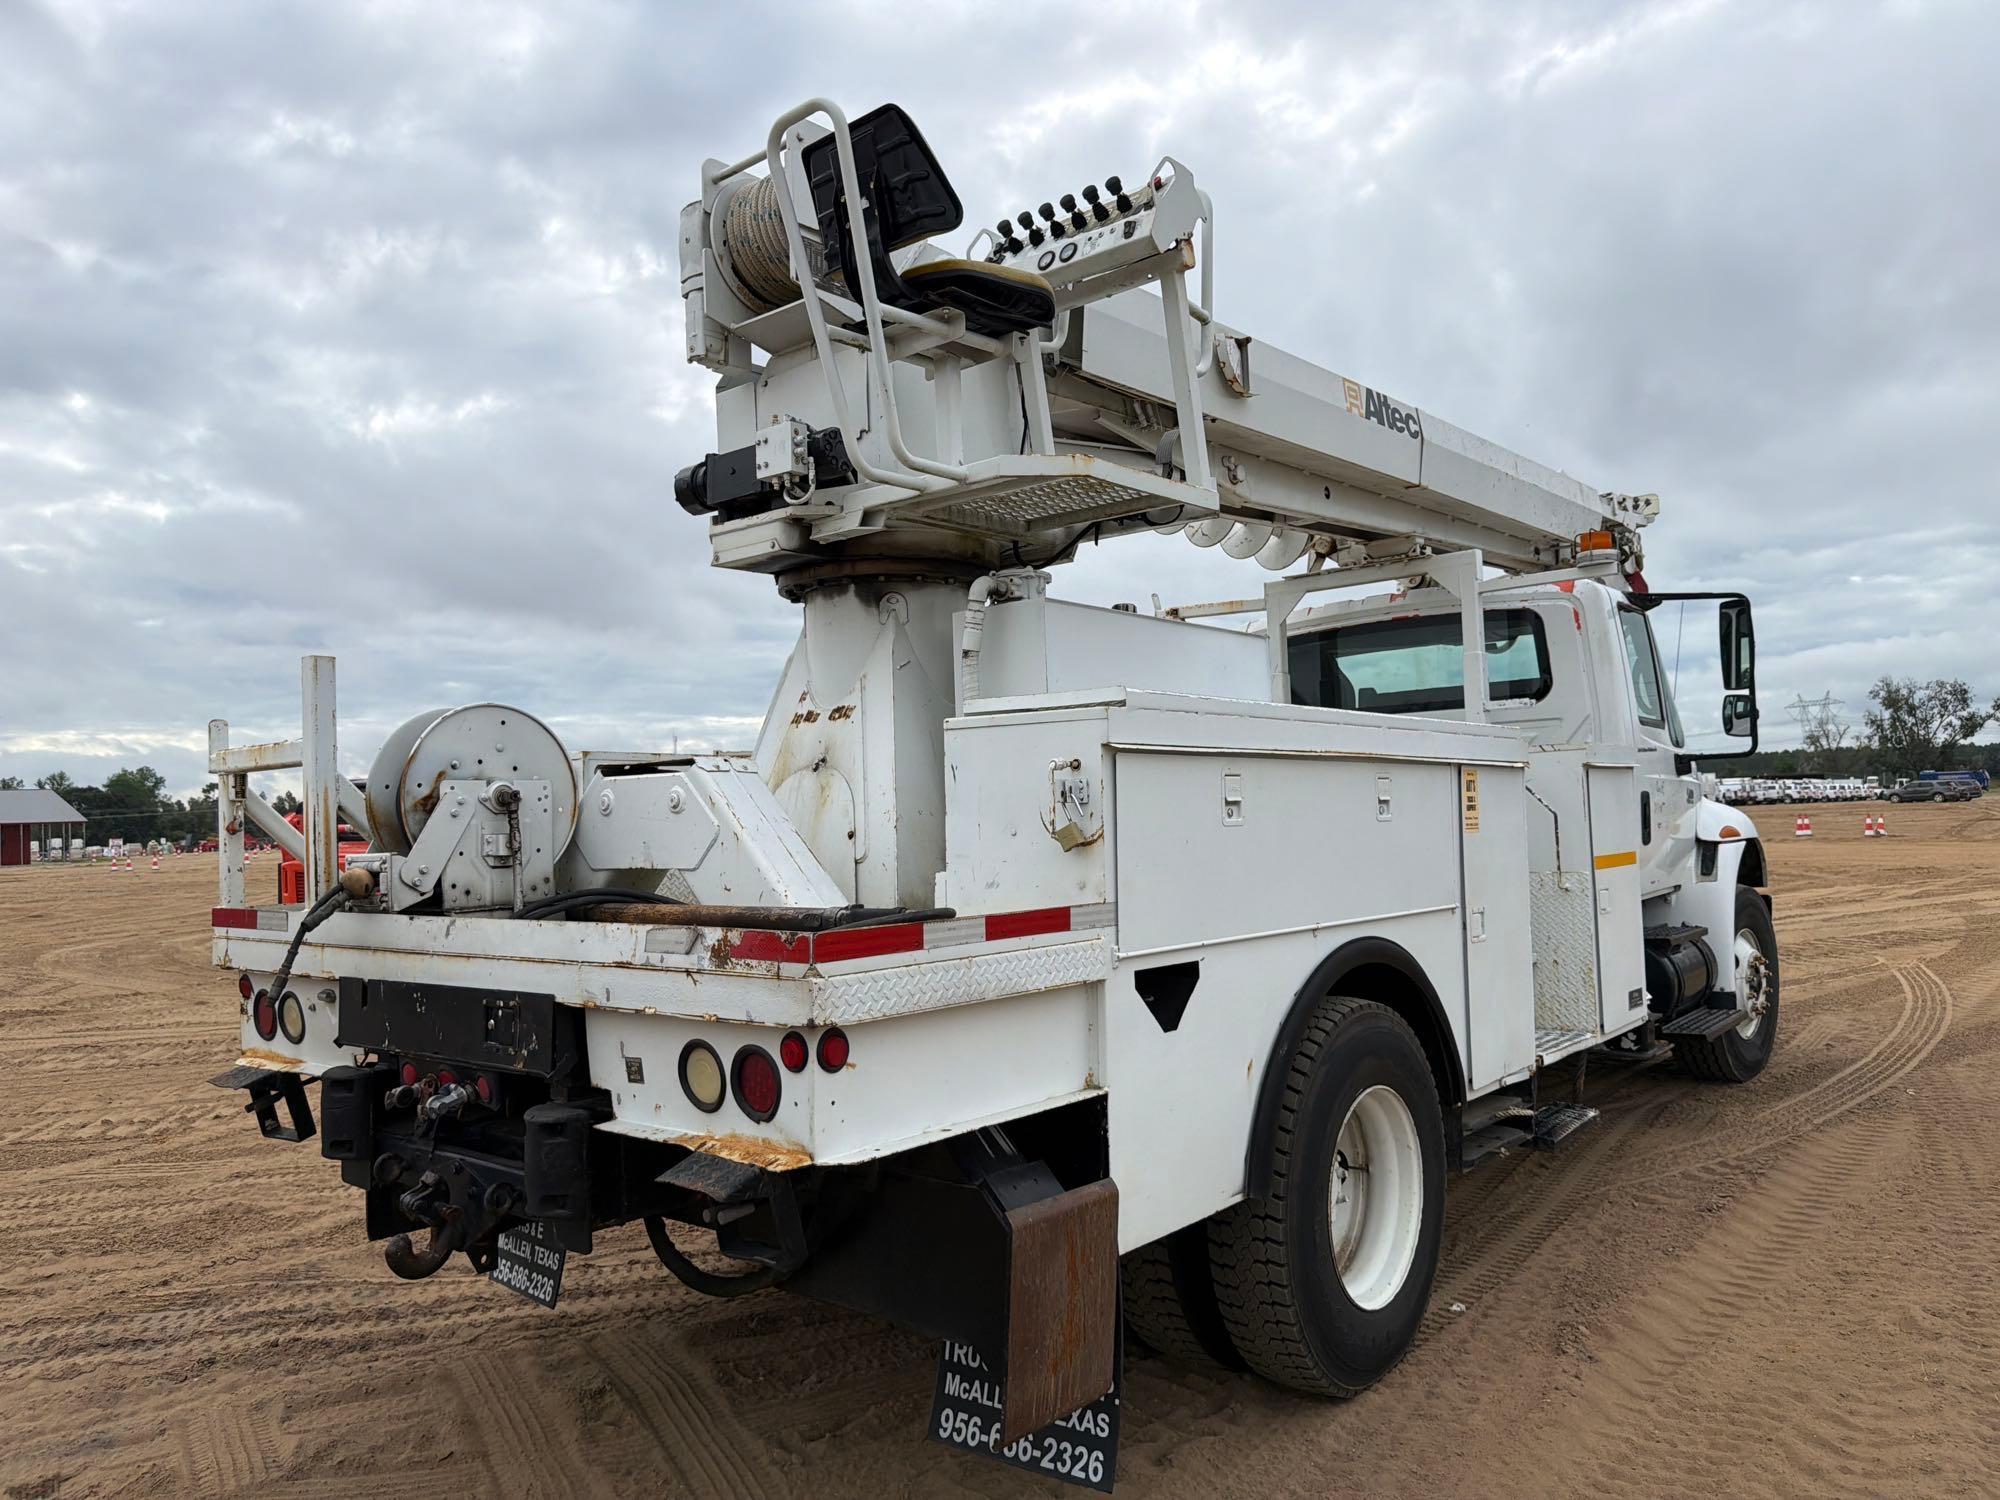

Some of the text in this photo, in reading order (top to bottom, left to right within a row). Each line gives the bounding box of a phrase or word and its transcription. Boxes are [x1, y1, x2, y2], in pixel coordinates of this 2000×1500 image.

[1365, 387, 1419, 440] Altec
[498, 1232, 560, 1271] McALLEN, TEXAS
[943, 1338, 989, 1372] TRU
[1054, 1407, 1110, 1438] XAS
